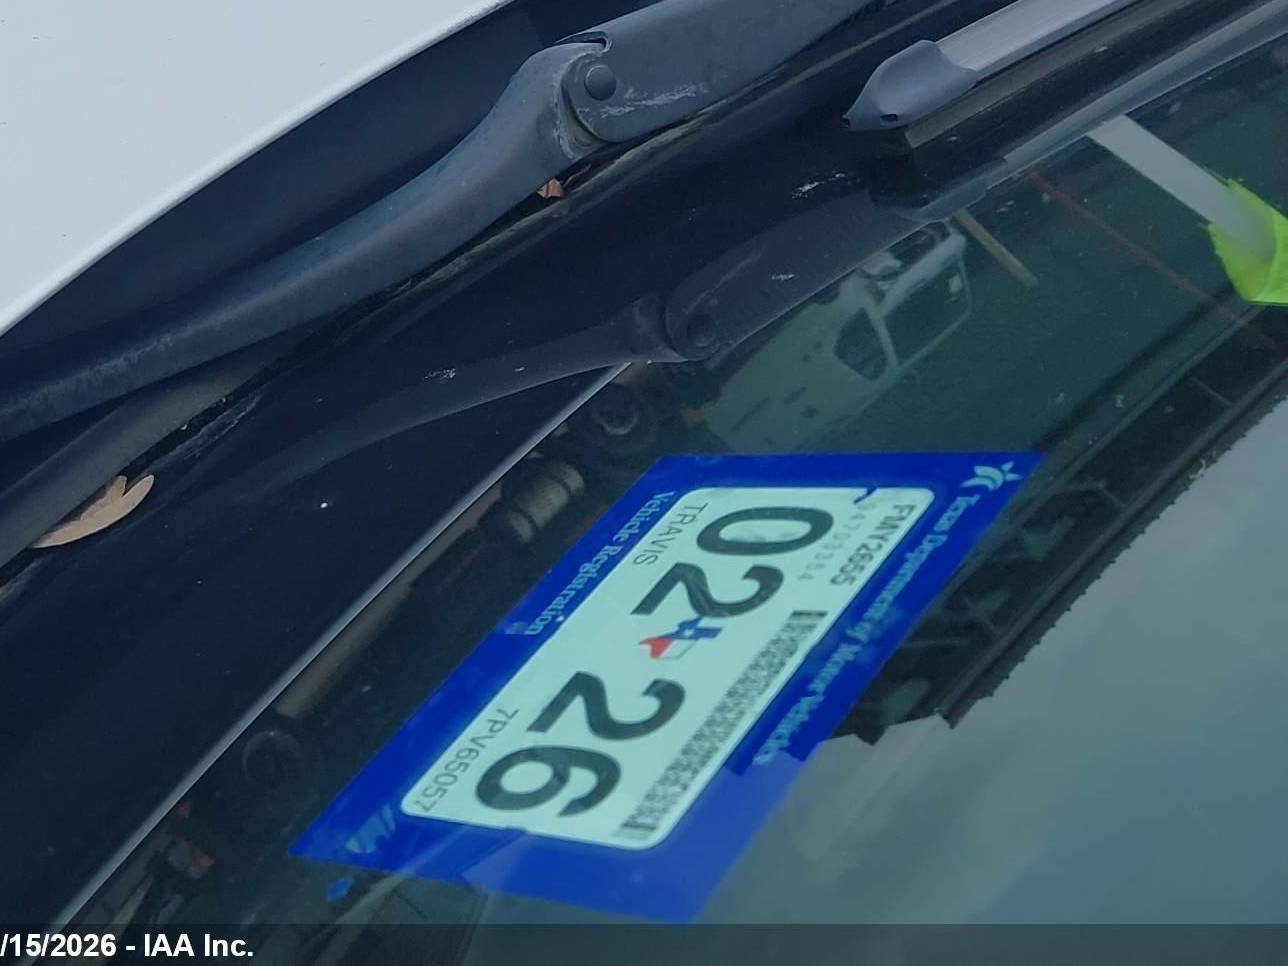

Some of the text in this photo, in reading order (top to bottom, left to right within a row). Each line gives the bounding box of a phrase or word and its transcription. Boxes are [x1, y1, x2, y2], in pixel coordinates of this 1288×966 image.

[632, 503, 708, 565] TRAVIS
[830, 504, 916, 585] FMY2655
[934, 495, 980, 532] Texas
[524, 491, 675, 634] Vehicle Registration
[863, 534, 947, 621] Department
[475, 507, 834, 816] 02 26
[809, 644, 862, 694] Motor
[414, 708, 519, 812] 7PV65057
[752, 696, 824, 768] Vehicles
